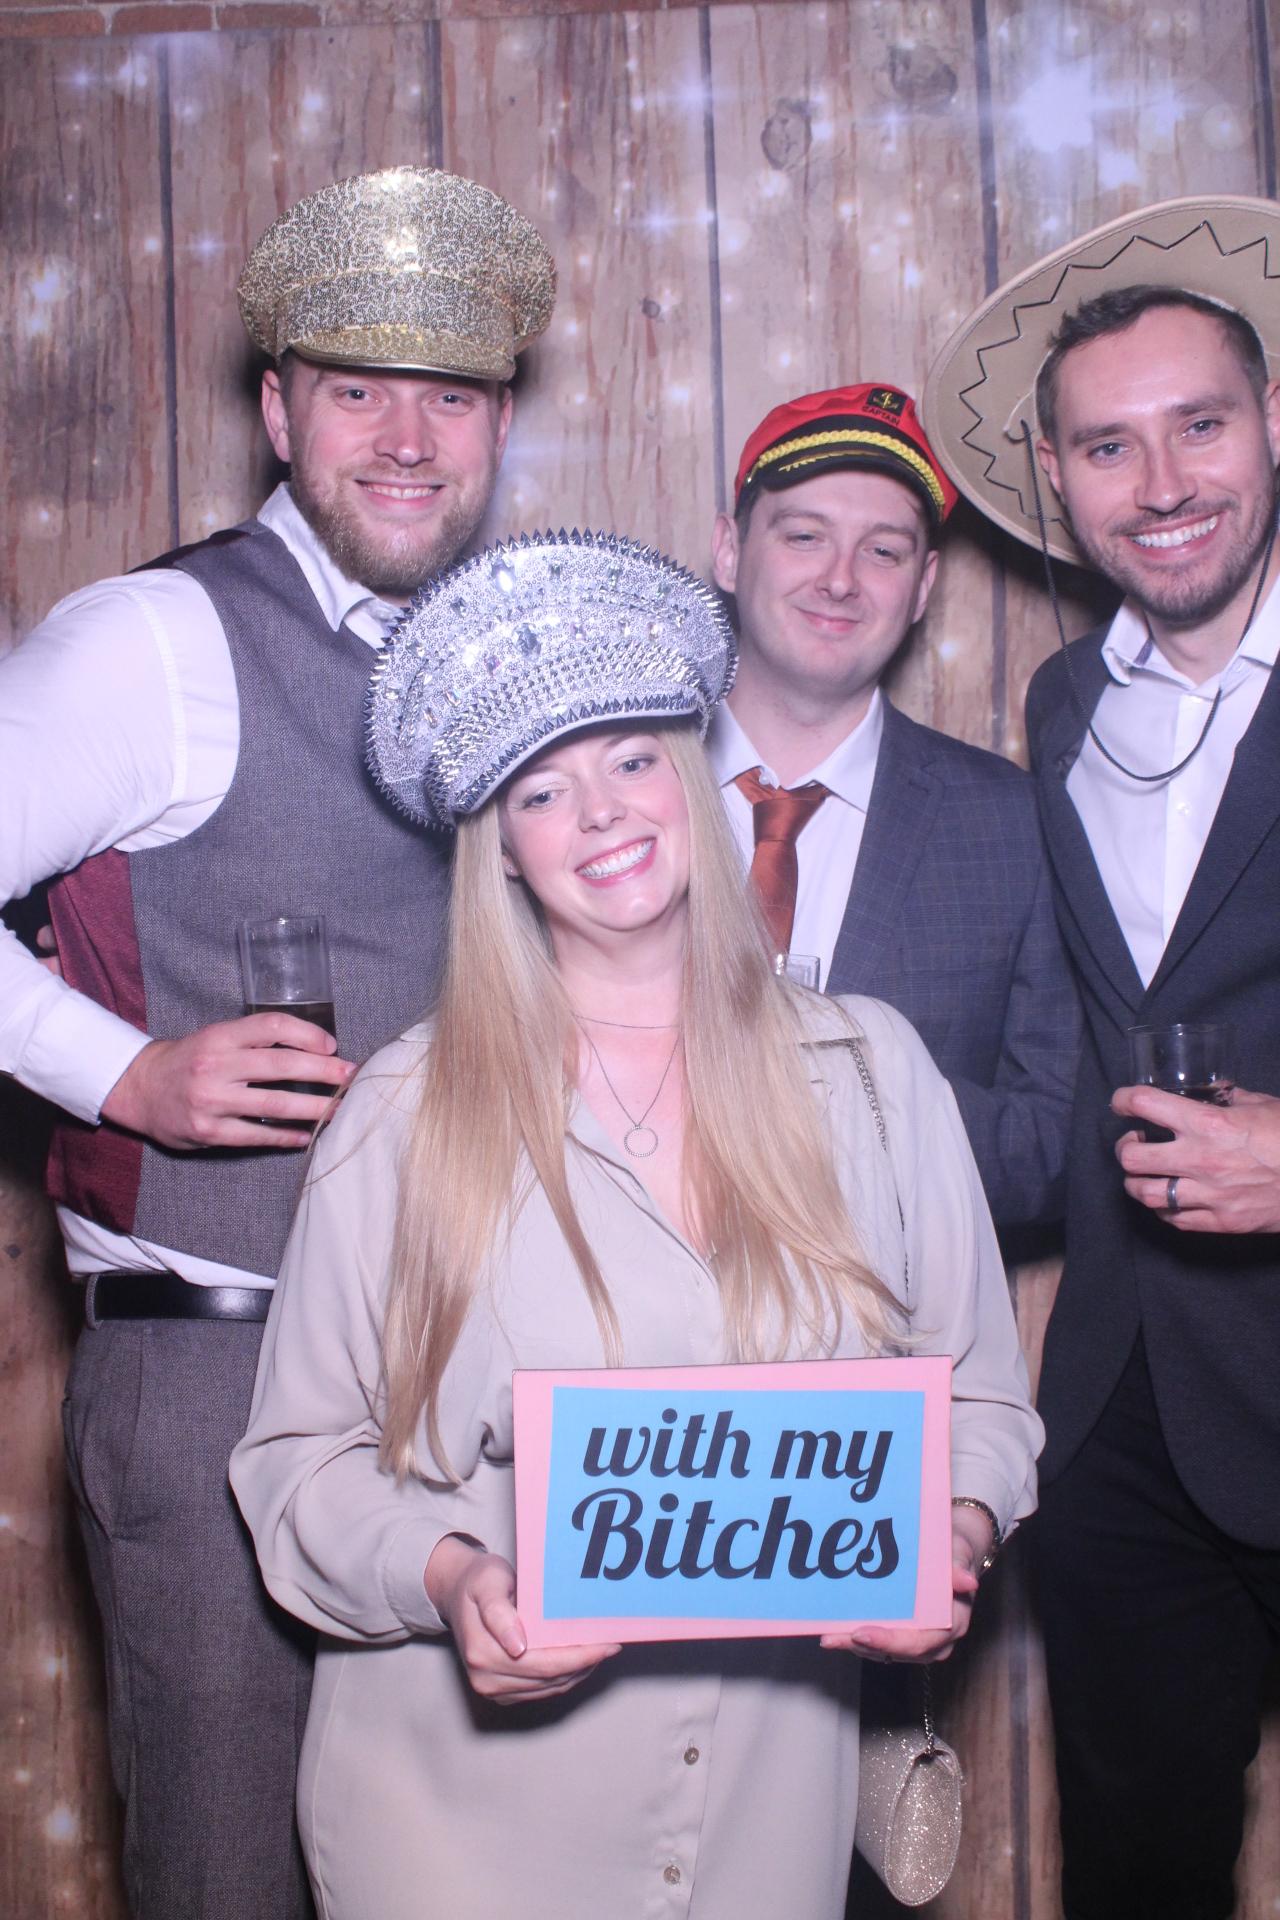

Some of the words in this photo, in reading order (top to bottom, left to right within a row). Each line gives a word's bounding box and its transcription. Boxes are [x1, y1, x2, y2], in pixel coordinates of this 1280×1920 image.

[861, 405, 900, 427] CAPTAIN
[583, 1408, 751, 1479] with
[770, 1430, 894, 1503] my
[571, 1487, 900, 1581] Bitches
